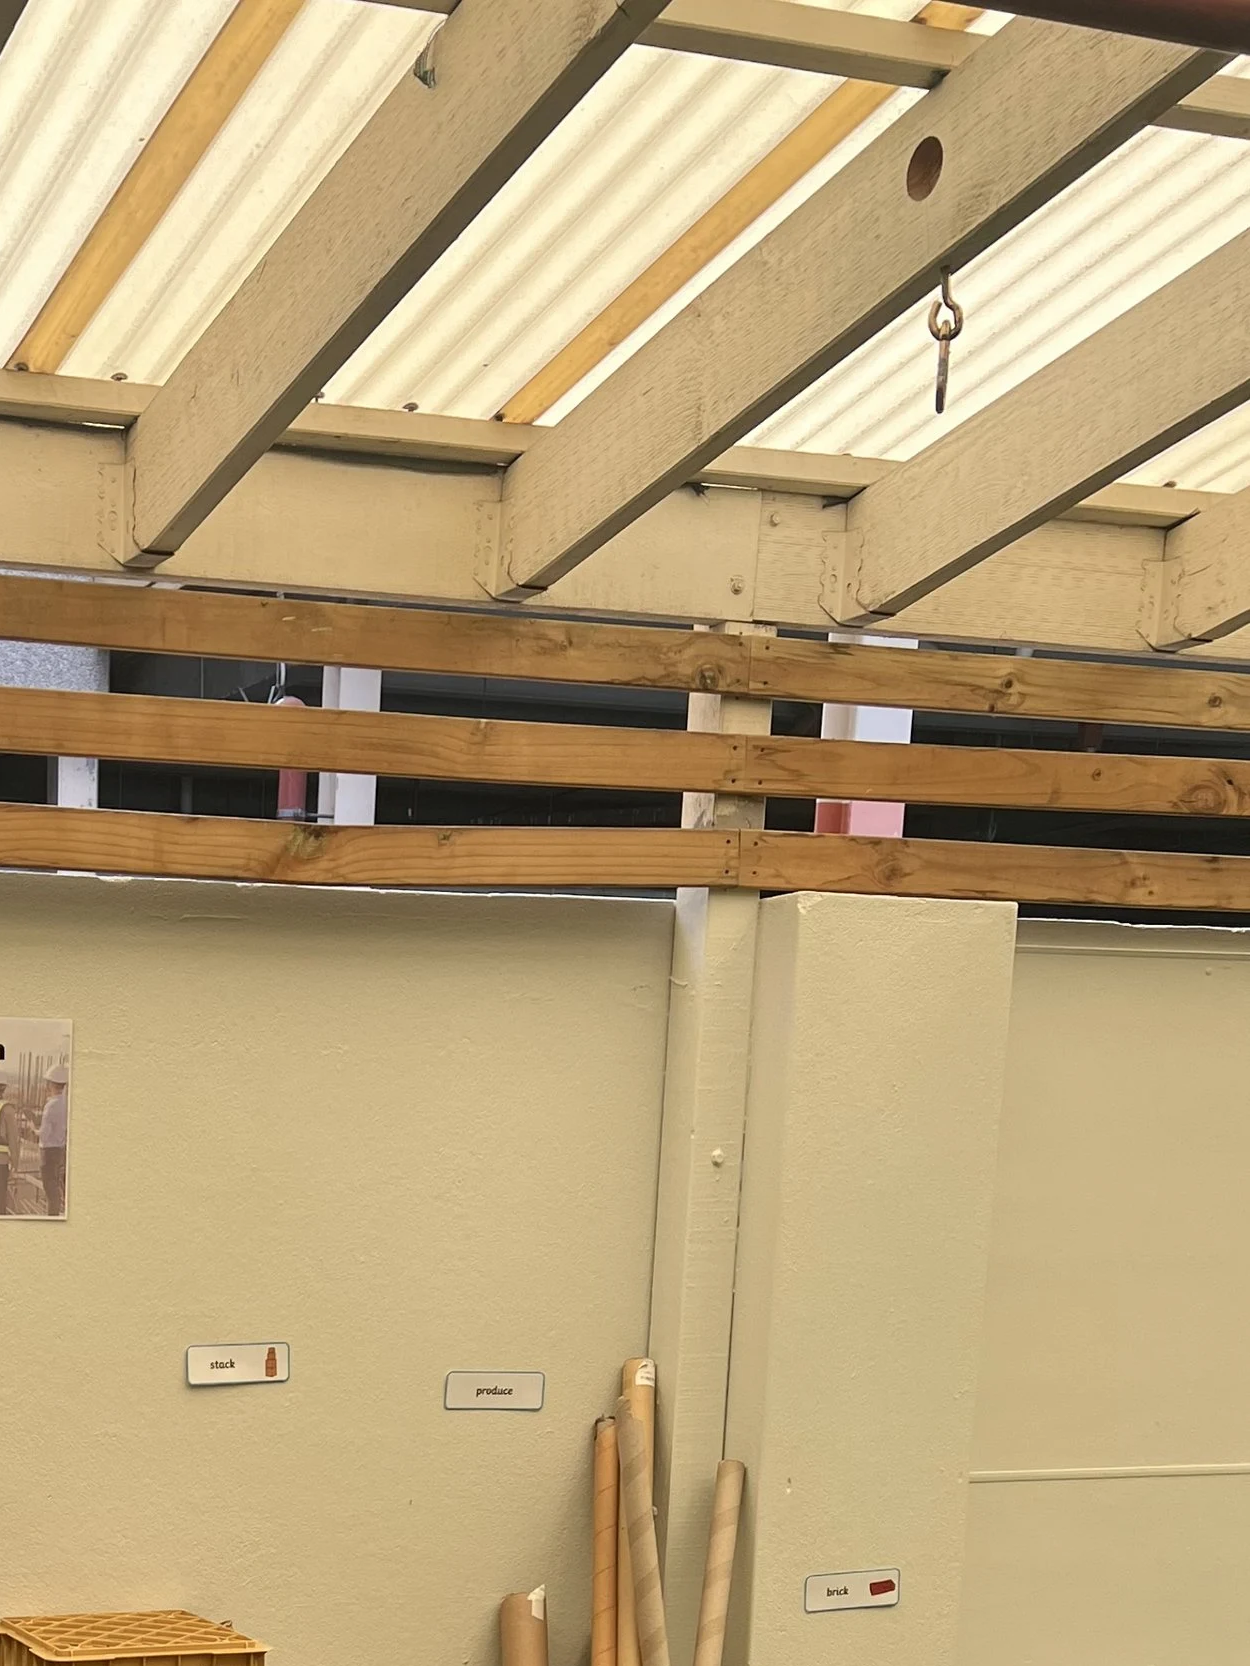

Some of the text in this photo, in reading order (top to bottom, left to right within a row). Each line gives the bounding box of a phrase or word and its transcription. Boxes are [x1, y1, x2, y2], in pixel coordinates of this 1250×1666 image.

[210, 1358, 236, 1370] stack
[475, 1385, 514, 1398] produce
[826, 1586, 849, 1597] brick
